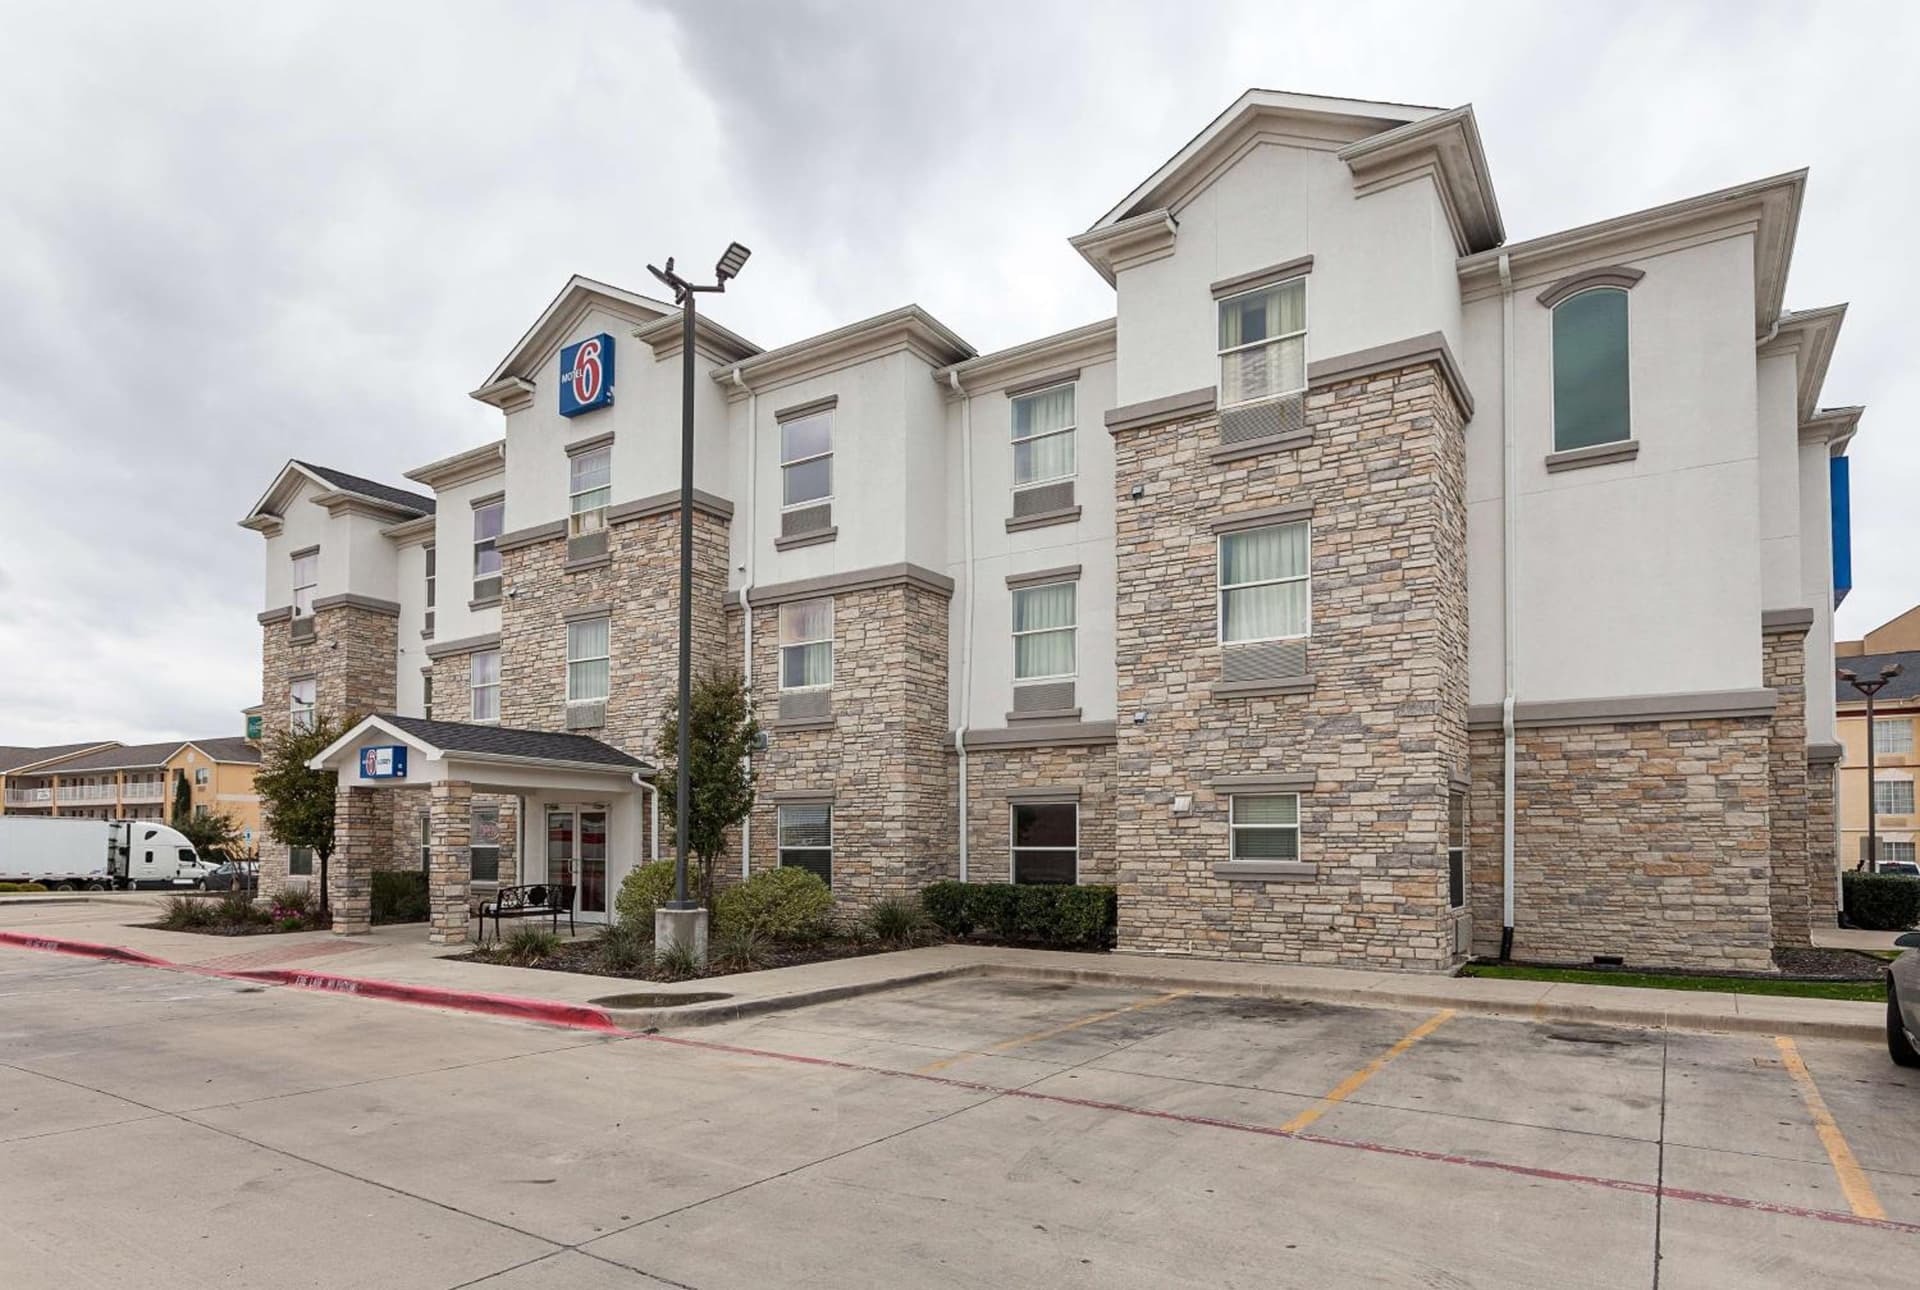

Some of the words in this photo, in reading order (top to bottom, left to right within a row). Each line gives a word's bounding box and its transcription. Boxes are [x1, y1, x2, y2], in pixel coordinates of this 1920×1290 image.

[561, 368, 583, 384] MOTEL
[572, 339, 602, 405] 6
[366, 749, 376, 776] 6
